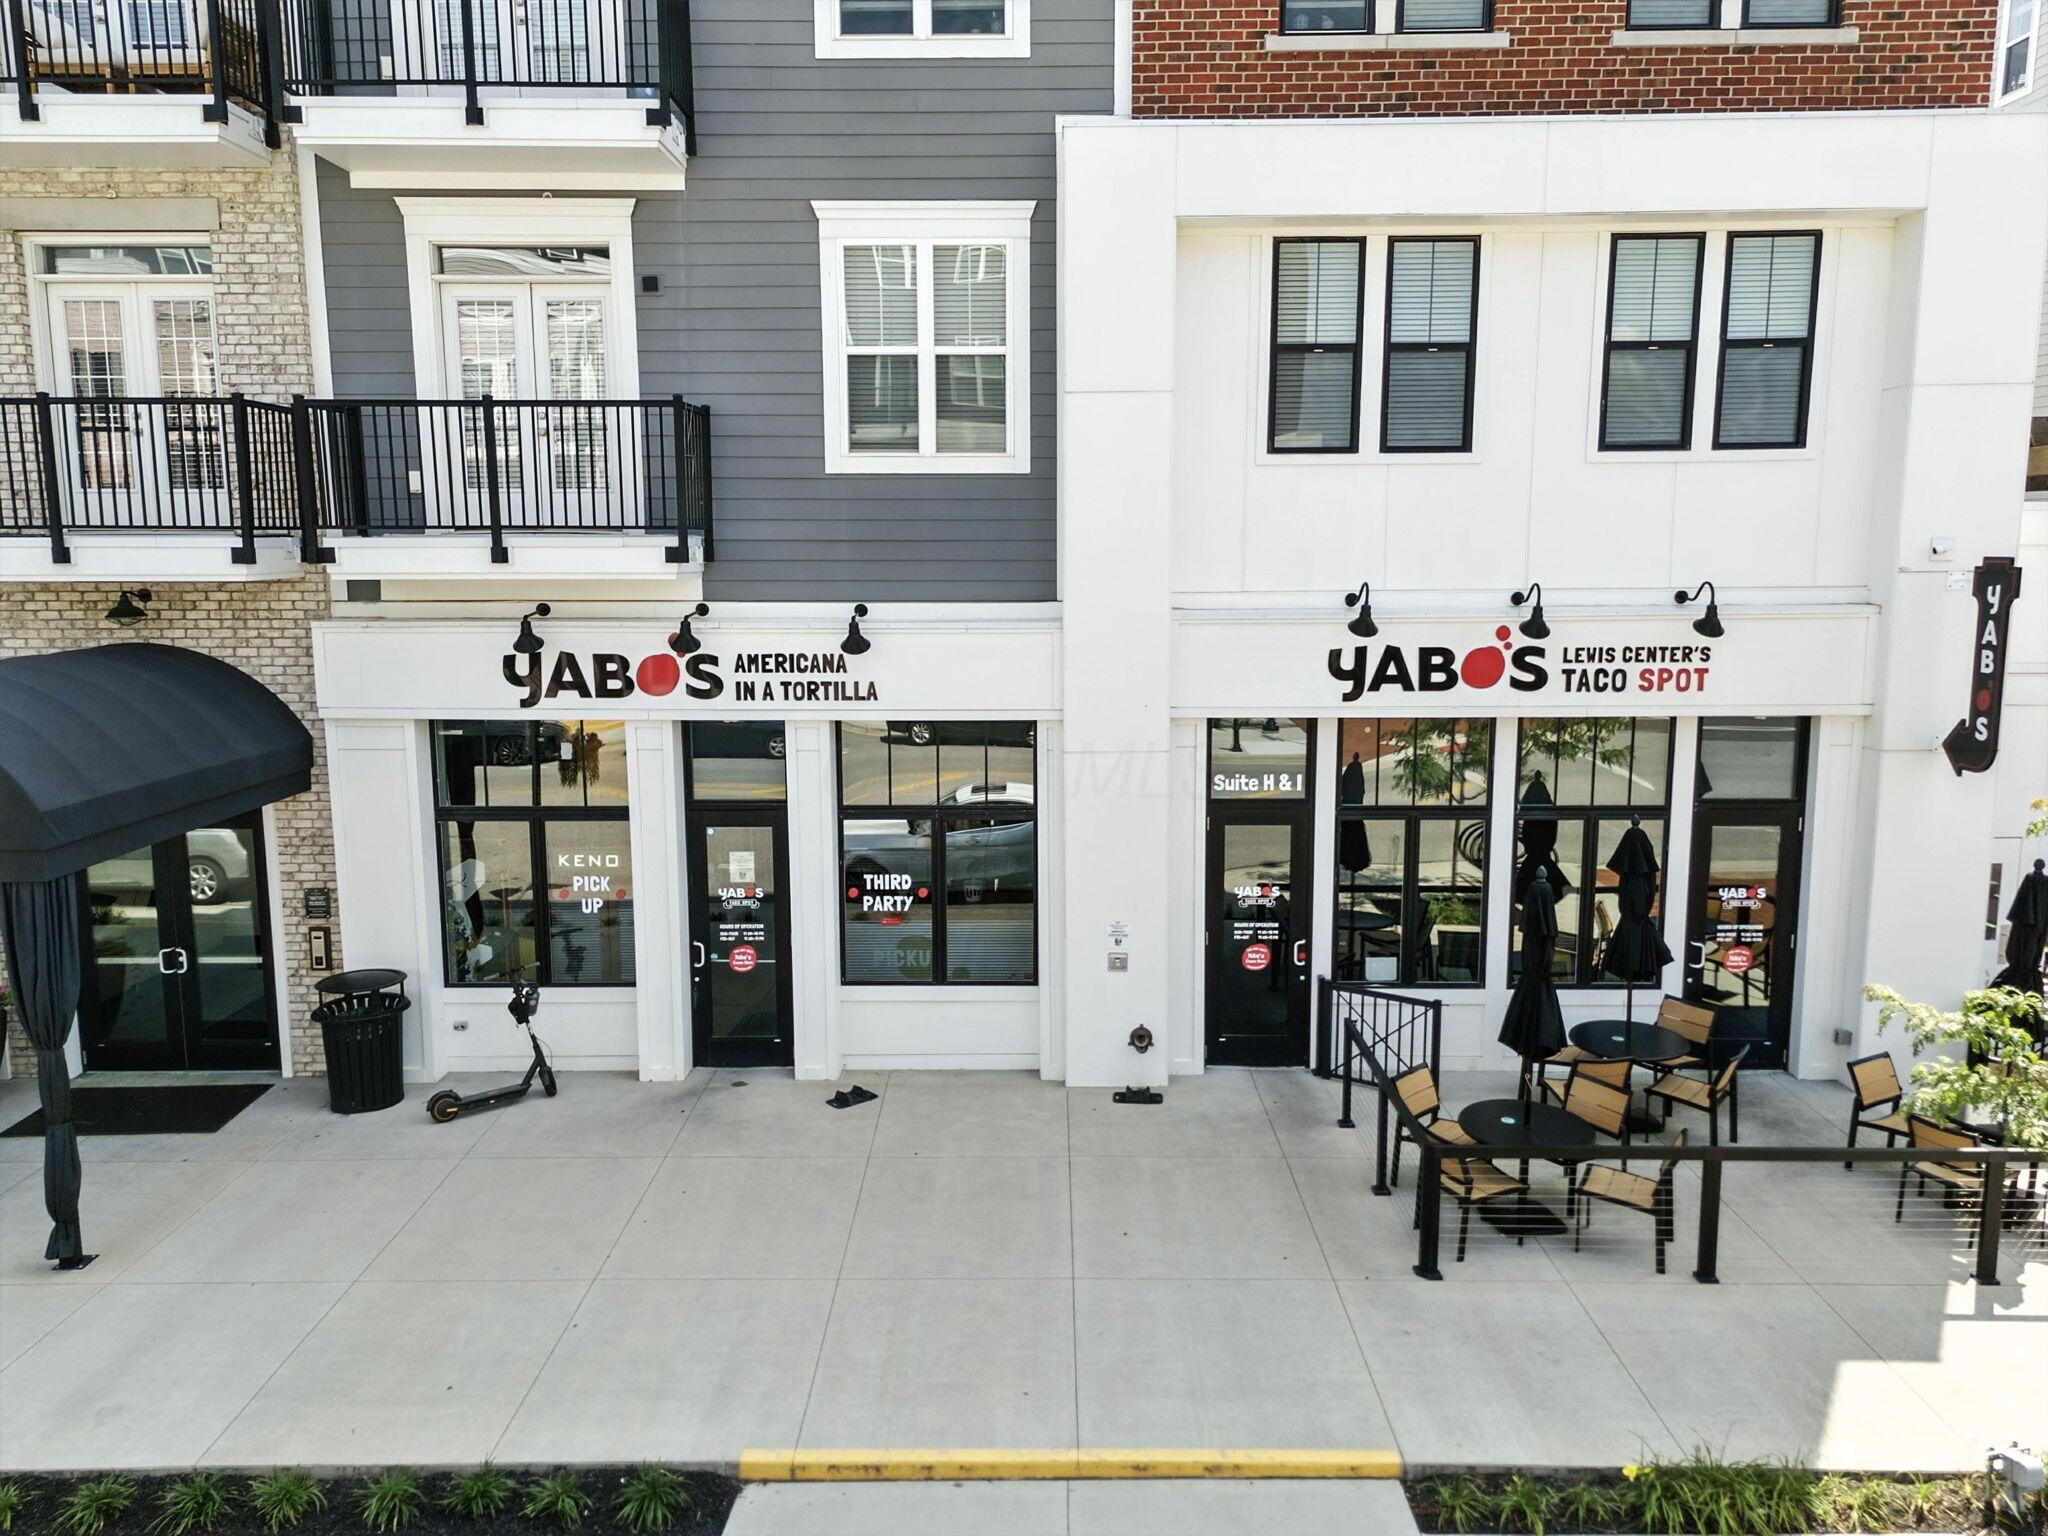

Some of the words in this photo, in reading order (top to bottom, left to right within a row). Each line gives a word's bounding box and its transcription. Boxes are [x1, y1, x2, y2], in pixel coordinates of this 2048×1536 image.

[1562, 646, 1615, 663] LEWIS
[1622, 645, 1711, 663] CENTER'S
[734, 653, 847, 674] AMERICANA
[1562, 668, 1627, 692] TACO
[1638, 667, 1709, 692] SPOT
[735, 681, 756, 701] IN
[762, 681, 774, 701] A
[780, 681, 878, 701] TORTILLA
[1213, 773, 1259, 791] Suite
[1263, 773, 1275, 791] H
[1278, 773, 1292, 791] &
[558, 854, 619, 867] KENO
[572, 875, 610, 892] PICK
[863, 874, 912, 890] THIRD
[581, 898, 603, 913] UP
[863, 895, 914, 911] PARTY
[873, 949, 930, 967] PICKU
